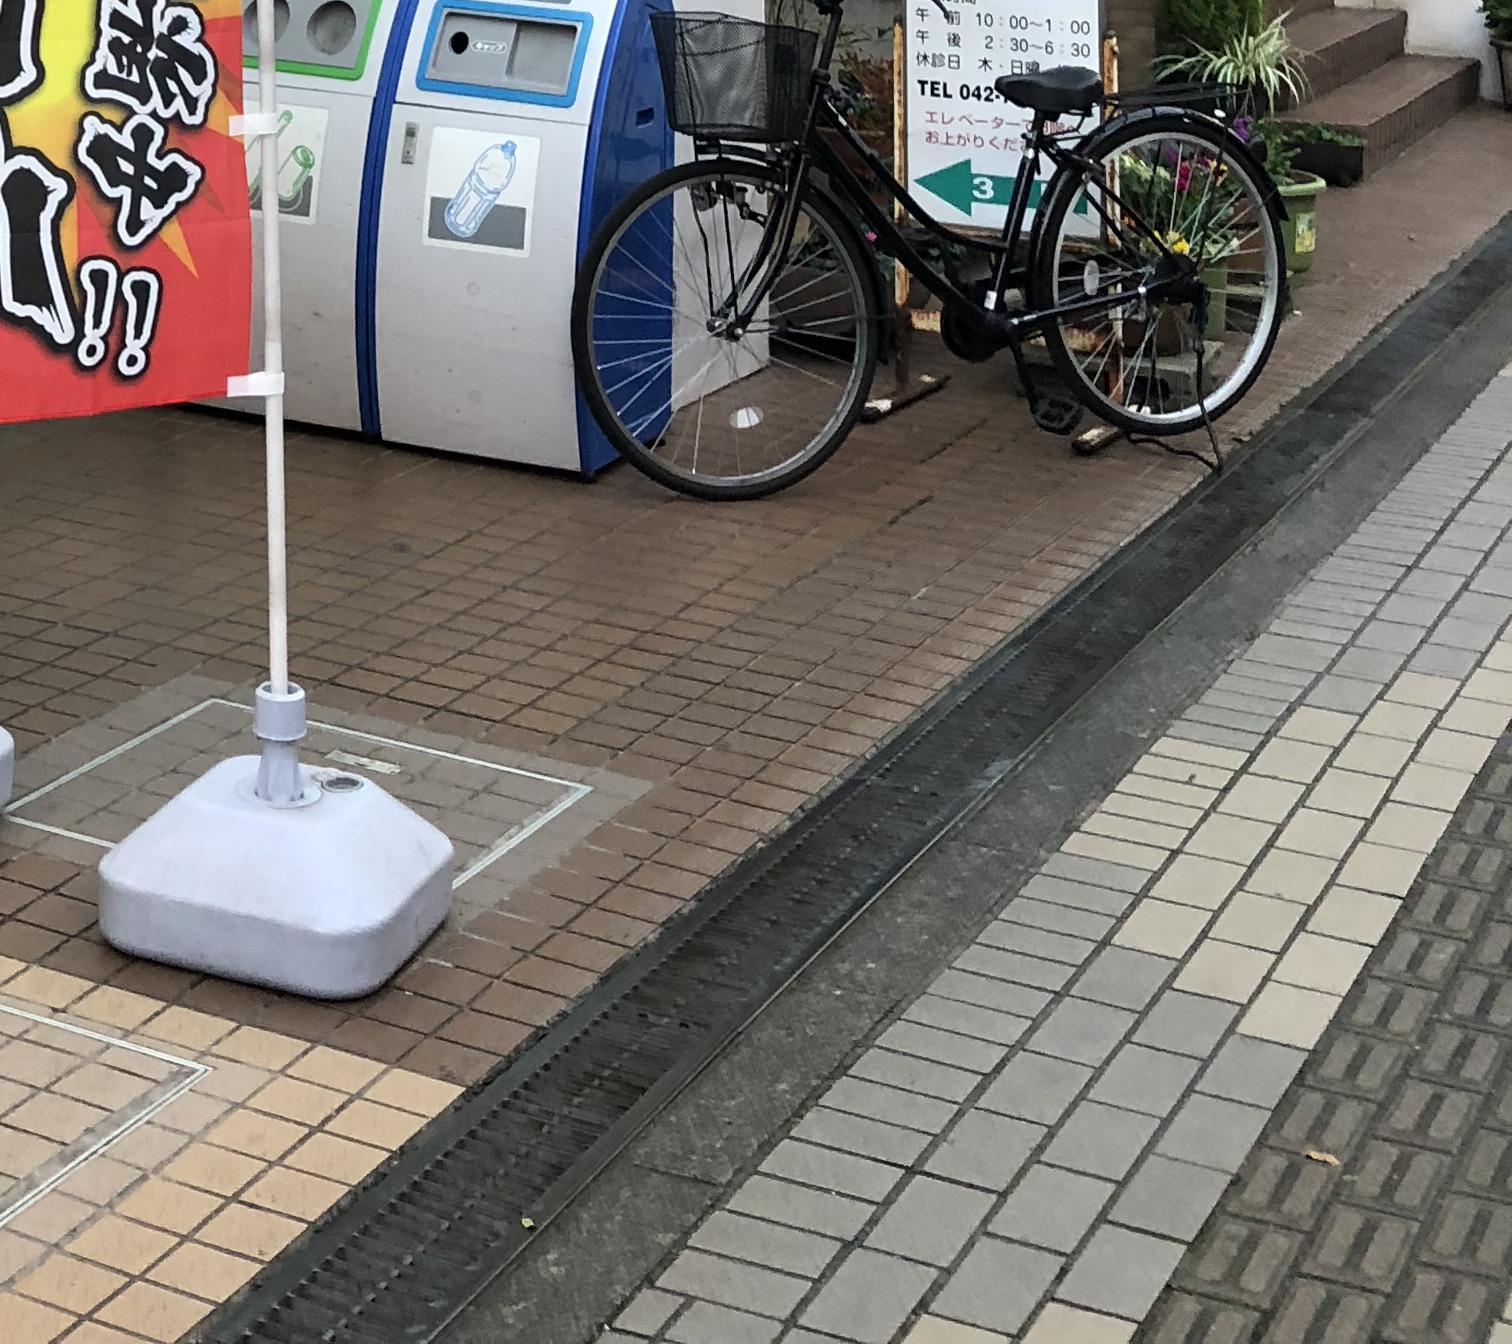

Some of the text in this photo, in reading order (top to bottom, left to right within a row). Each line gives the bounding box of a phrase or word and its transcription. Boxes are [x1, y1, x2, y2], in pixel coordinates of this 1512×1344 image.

[472, 41, 506, 53] キャップ
[915, 51, 961, 70] 休診日
[917, 79, 1008, 104] TEL 042-
